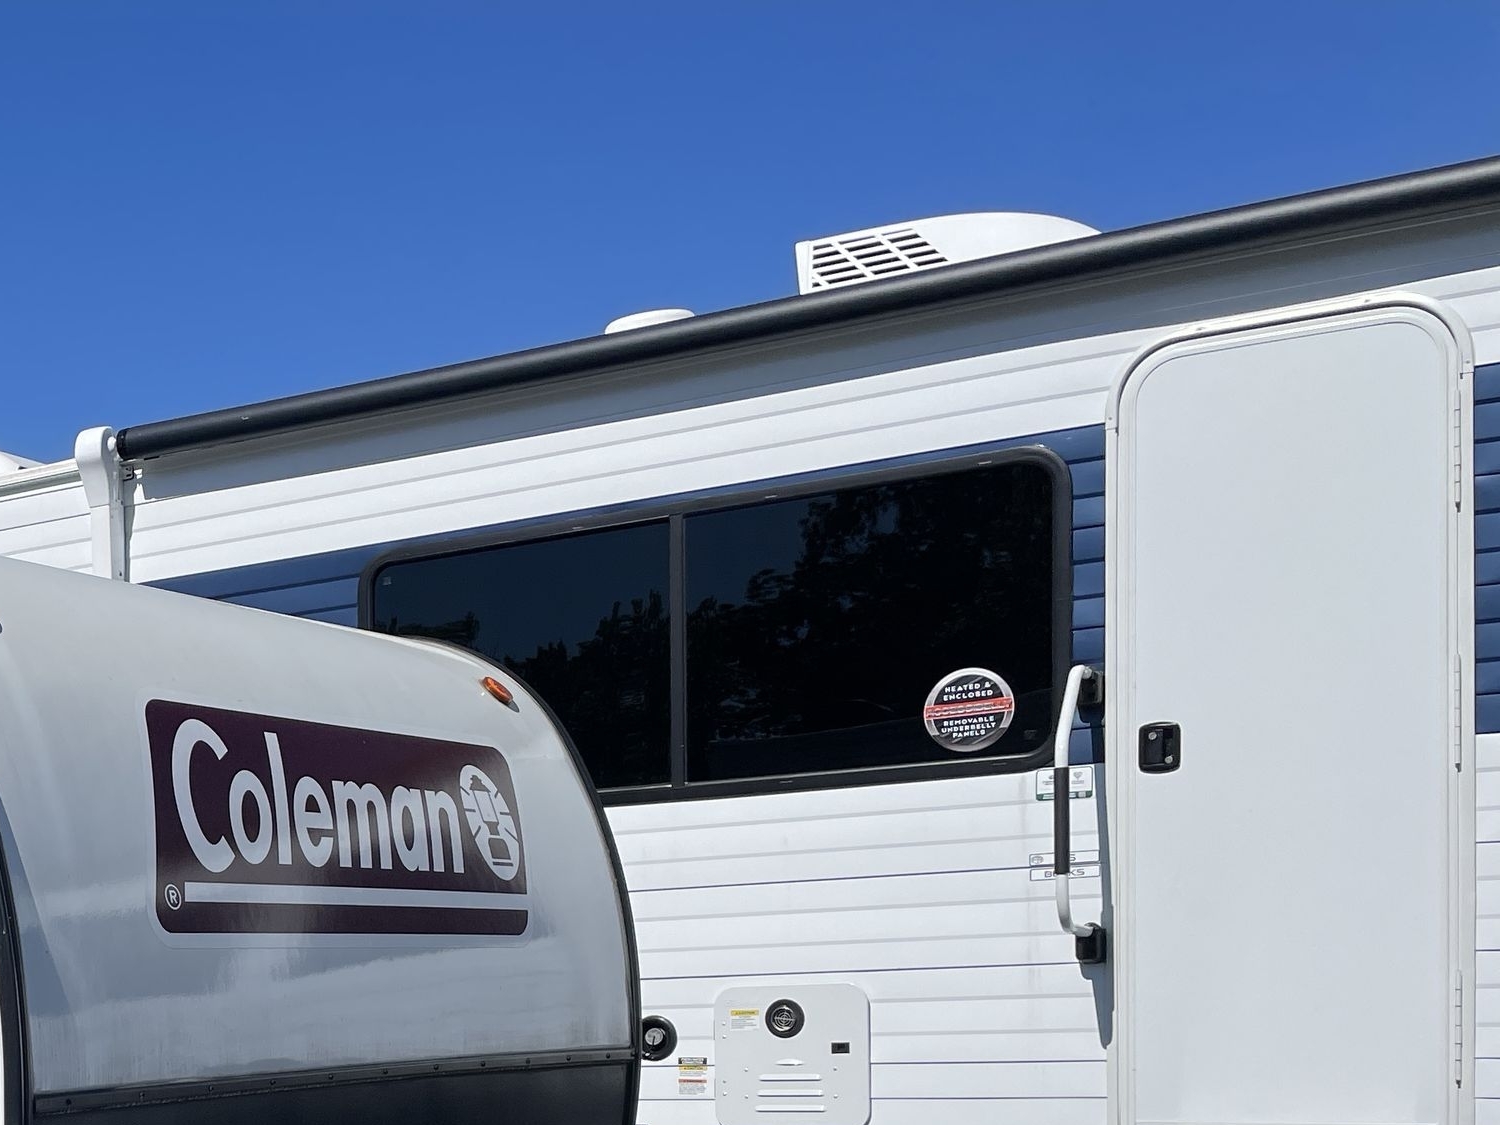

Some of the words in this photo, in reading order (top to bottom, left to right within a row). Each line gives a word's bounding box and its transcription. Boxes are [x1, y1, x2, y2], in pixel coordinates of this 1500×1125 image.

[944, 683, 981, 693] HEATED
[943, 689, 994, 702] ENCLOSED
[943, 715, 995, 727] REMOVABLE
[941, 722, 997, 733] UNDERBELLY
[952, 729, 986, 739] PANELS
[171, 718, 466, 873] Coleman
